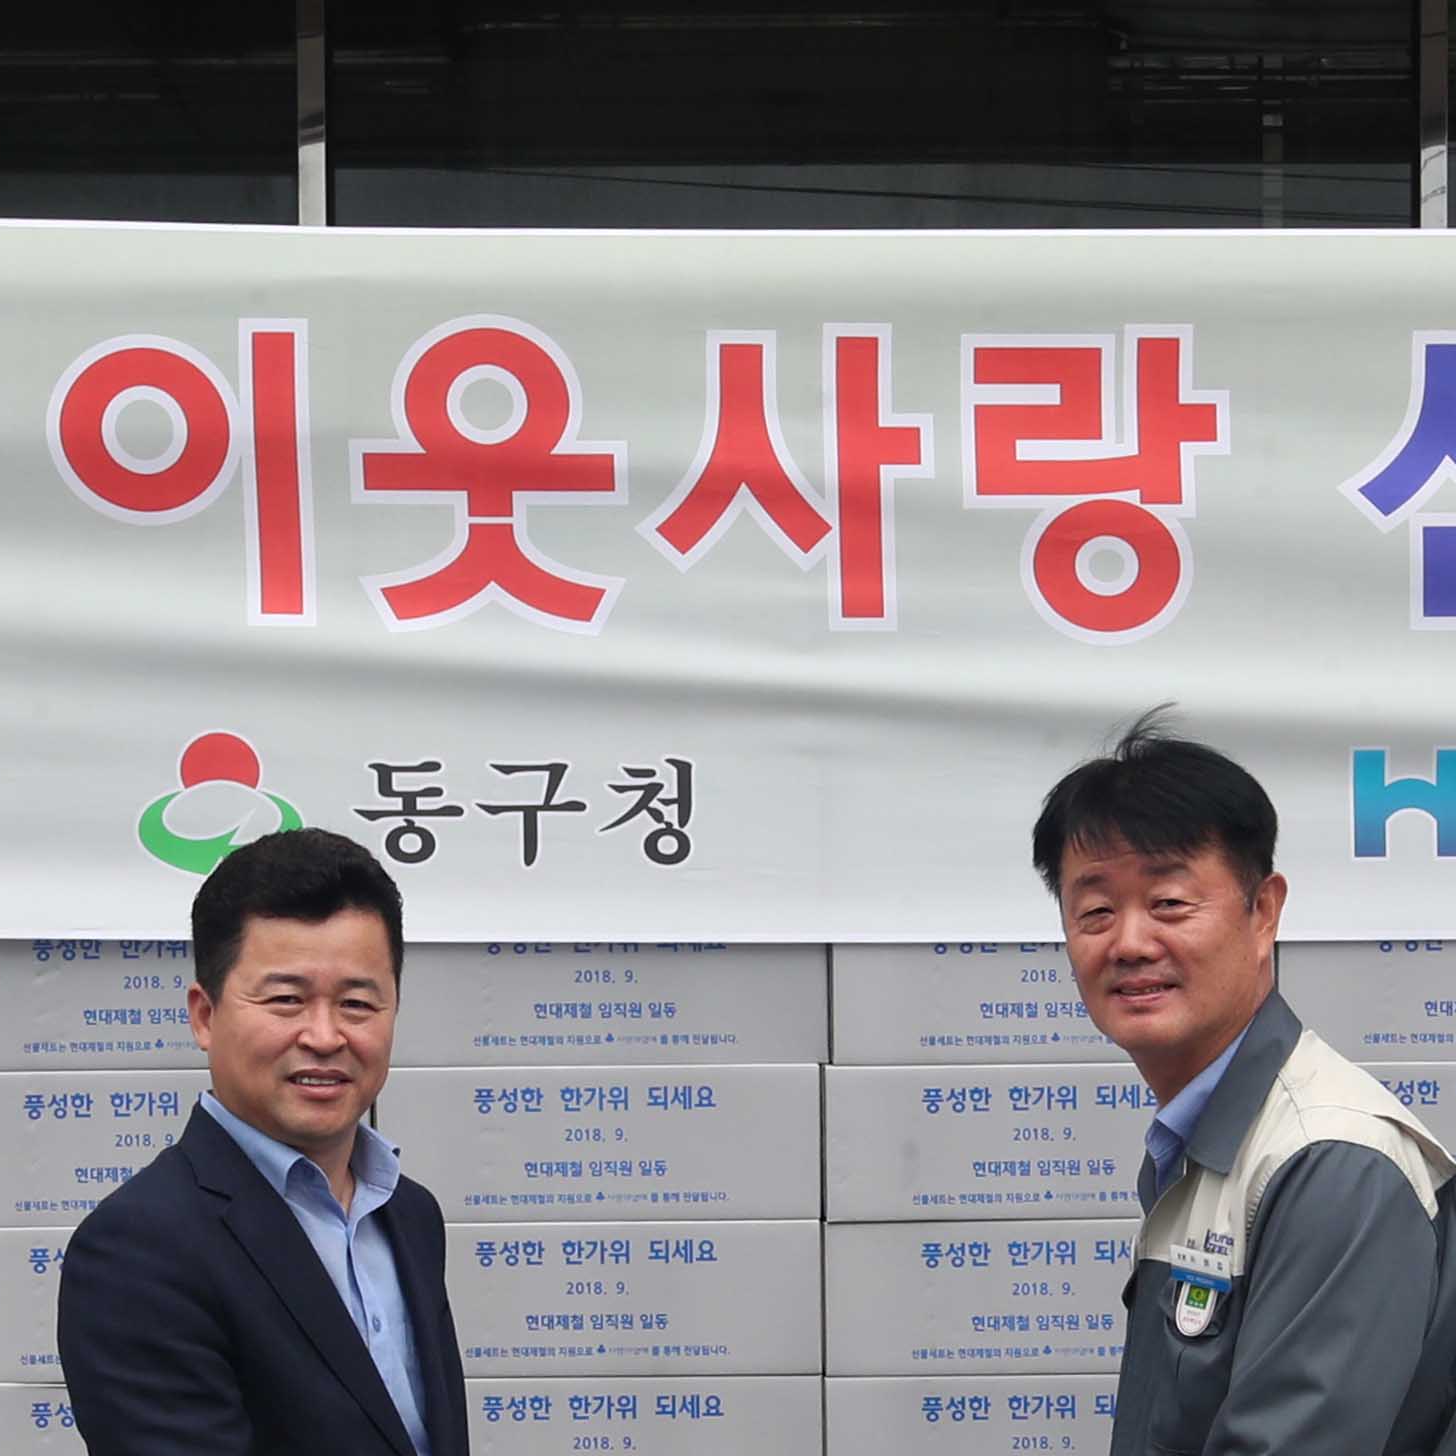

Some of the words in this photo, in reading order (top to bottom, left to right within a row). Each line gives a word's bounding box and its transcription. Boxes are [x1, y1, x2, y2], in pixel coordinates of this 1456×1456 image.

[54, 322, 1224, 638] 이웃사랑
[351, 757, 693, 867] 동구청
[475, 1240, 545, 1267] 풍성한
[561, 1238, 631, 1266] 한가위
[648, 1237, 717, 1264] 되세요
[526, 1314, 585, 1331] 현대제철
[590, 1313, 633, 1330] 임직원
[640, 1313, 668, 1330] 일동
